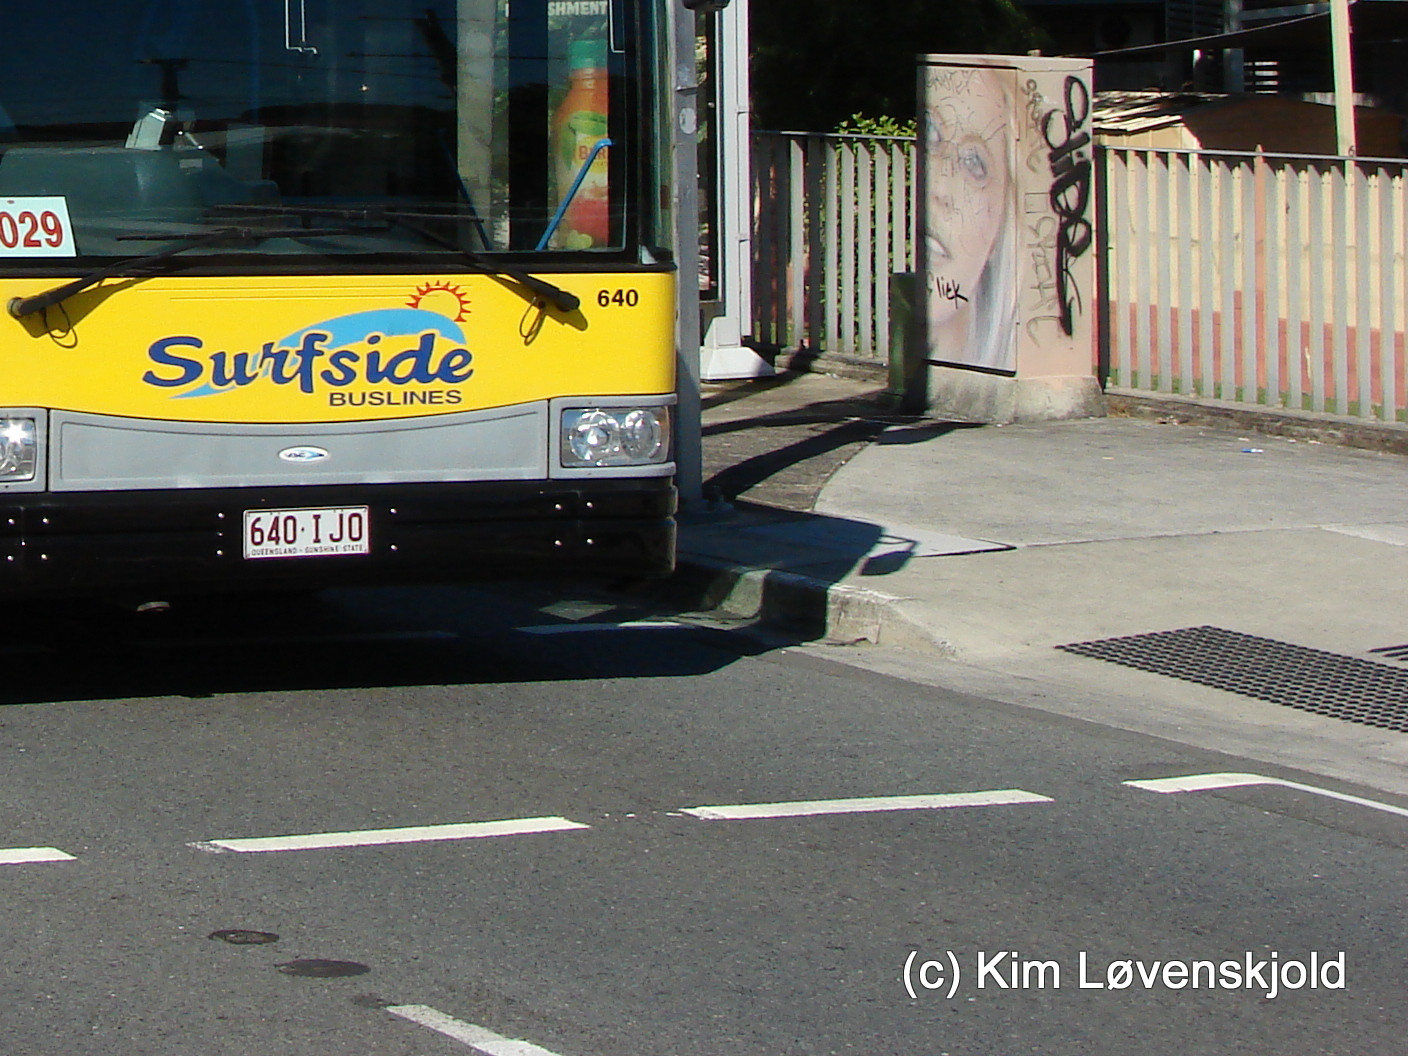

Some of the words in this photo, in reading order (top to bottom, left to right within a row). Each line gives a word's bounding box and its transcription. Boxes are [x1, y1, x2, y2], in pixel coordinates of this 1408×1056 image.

[597, 289, 639, 308] 640
[142, 332, 474, 394] Surfside
[328, 389, 463, 407] BUSLINES
[343, 544, 363, 552] STATE
